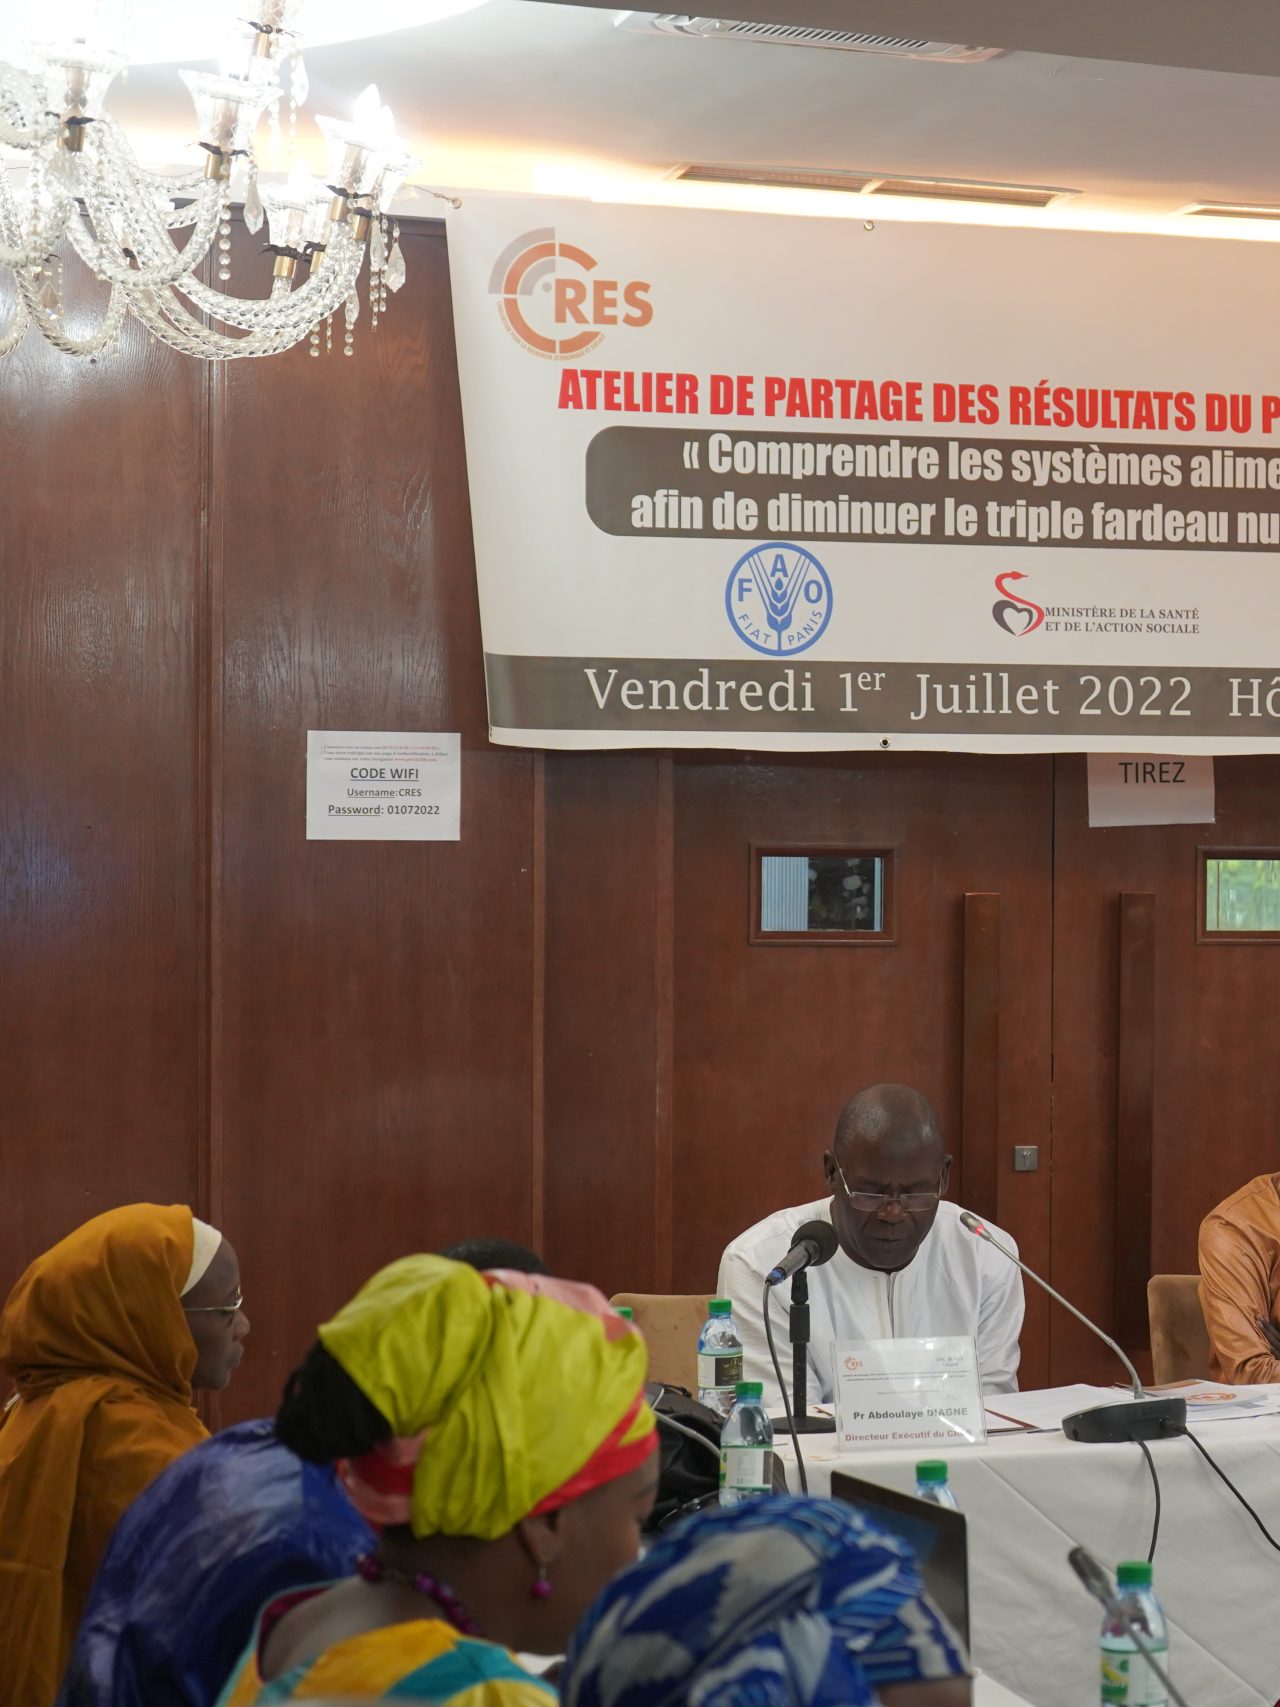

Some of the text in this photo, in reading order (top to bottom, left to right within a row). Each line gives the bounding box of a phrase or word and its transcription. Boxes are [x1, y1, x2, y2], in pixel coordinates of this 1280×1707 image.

[558, 368, 699, 414] ATELIER
[710, 375, 754, 416] DE
[765, 376, 923, 422] PARTAGE
[933, 383, 999, 425] DES
[1010, 379, 1196, 431] RÉSULTATS
[1206, 393, 1252, 434] DU
[708, 432, 940, 480] Comprendre
[948, 441, 1003, 482] les
[1011, 444, 1183, 487] systèmes
[631, 488, 703, 529] afin
[712, 491, 759, 531] de
[767, 493, 936, 537] diminuer
[944, 498, 978, 538] le
[986, 500, 1084, 543] triple
[1092, 502, 1229, 544] fardeau
[738, 554, 823, 604] FAO
[1045, 605, 1200, 620] MINISTÈRE DE LA SANTÉ
[738, 610, 823, 646] FIAT PANIS
[1045, 621, 1061, 632] ET
[1064, 621, 1083, 632] DE
[1146, 622, 1200, 634] SOCIALE
[584, 668, 815, 712] Vendredi
[838, 669, 886, 712] 1er
[911, 673, 1061, 720] Juillet
[1079, 676, 1193, 717] 2022
[350, 767, 419, 780] CODE WIFI
[1118, 762, 1187, 785] TIREZ
[328, 805, 440, 816] Password: 01072022
[854, 1412, 865, 1420] Pr
[868, 1410, 924, 1420] Abdoulaye
[845, 1433, 889, 1442] Directeur
[934, 1430, 945, 1438] du
